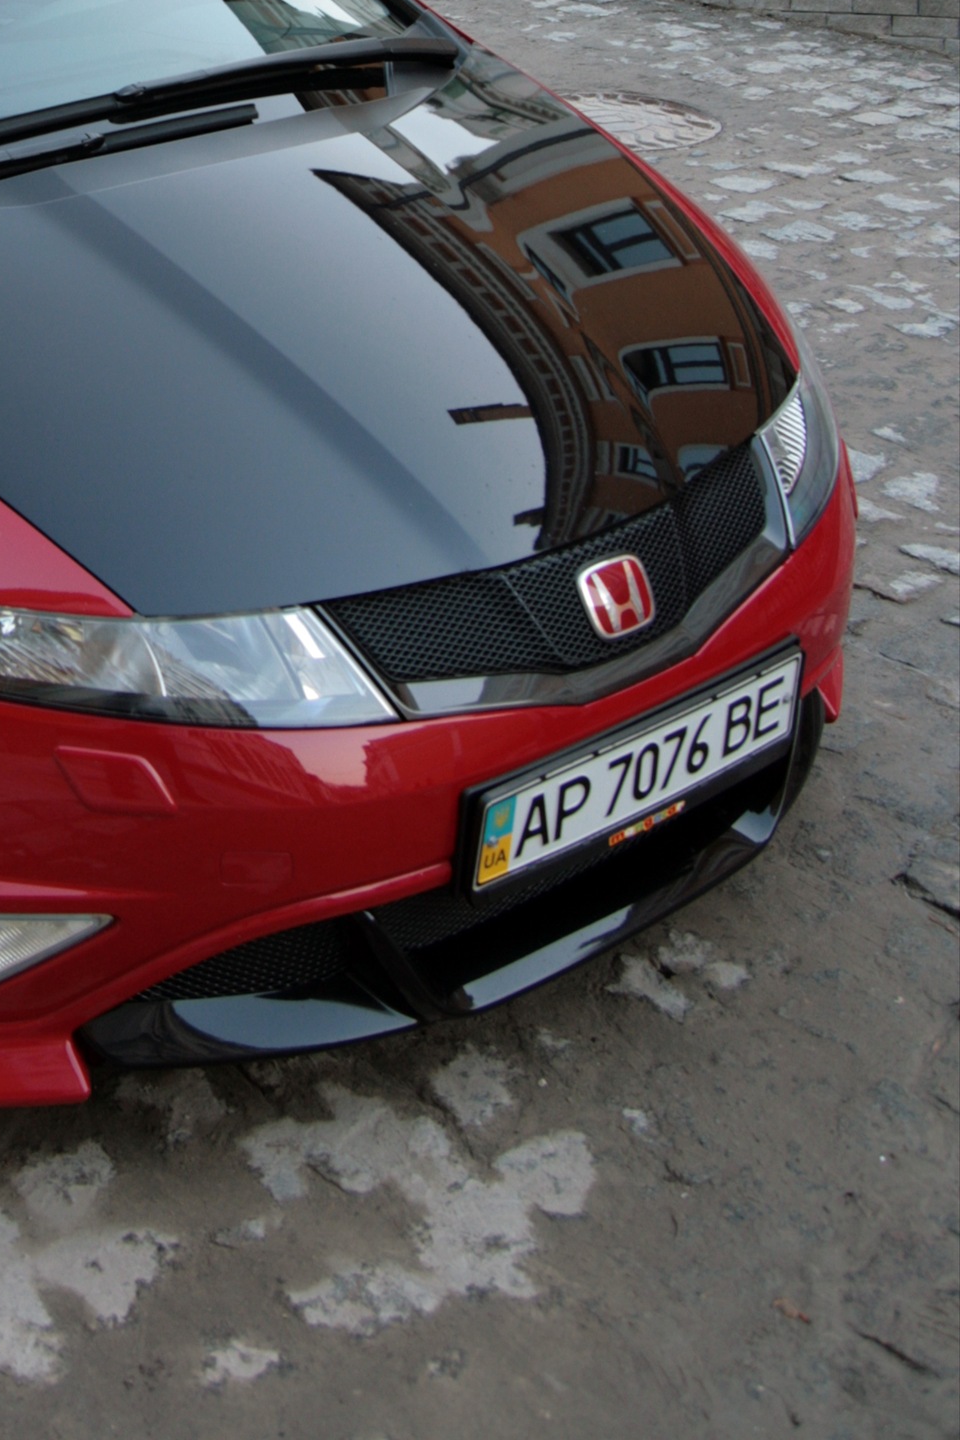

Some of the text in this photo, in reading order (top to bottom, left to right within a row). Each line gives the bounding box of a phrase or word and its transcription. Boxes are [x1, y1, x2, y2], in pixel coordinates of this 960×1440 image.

[514, 775, 591, 858] AP
[605, 713, 713, 817] 7076
[722, 675, 785, 758] BE
[484, 849, 507, 869] UA
